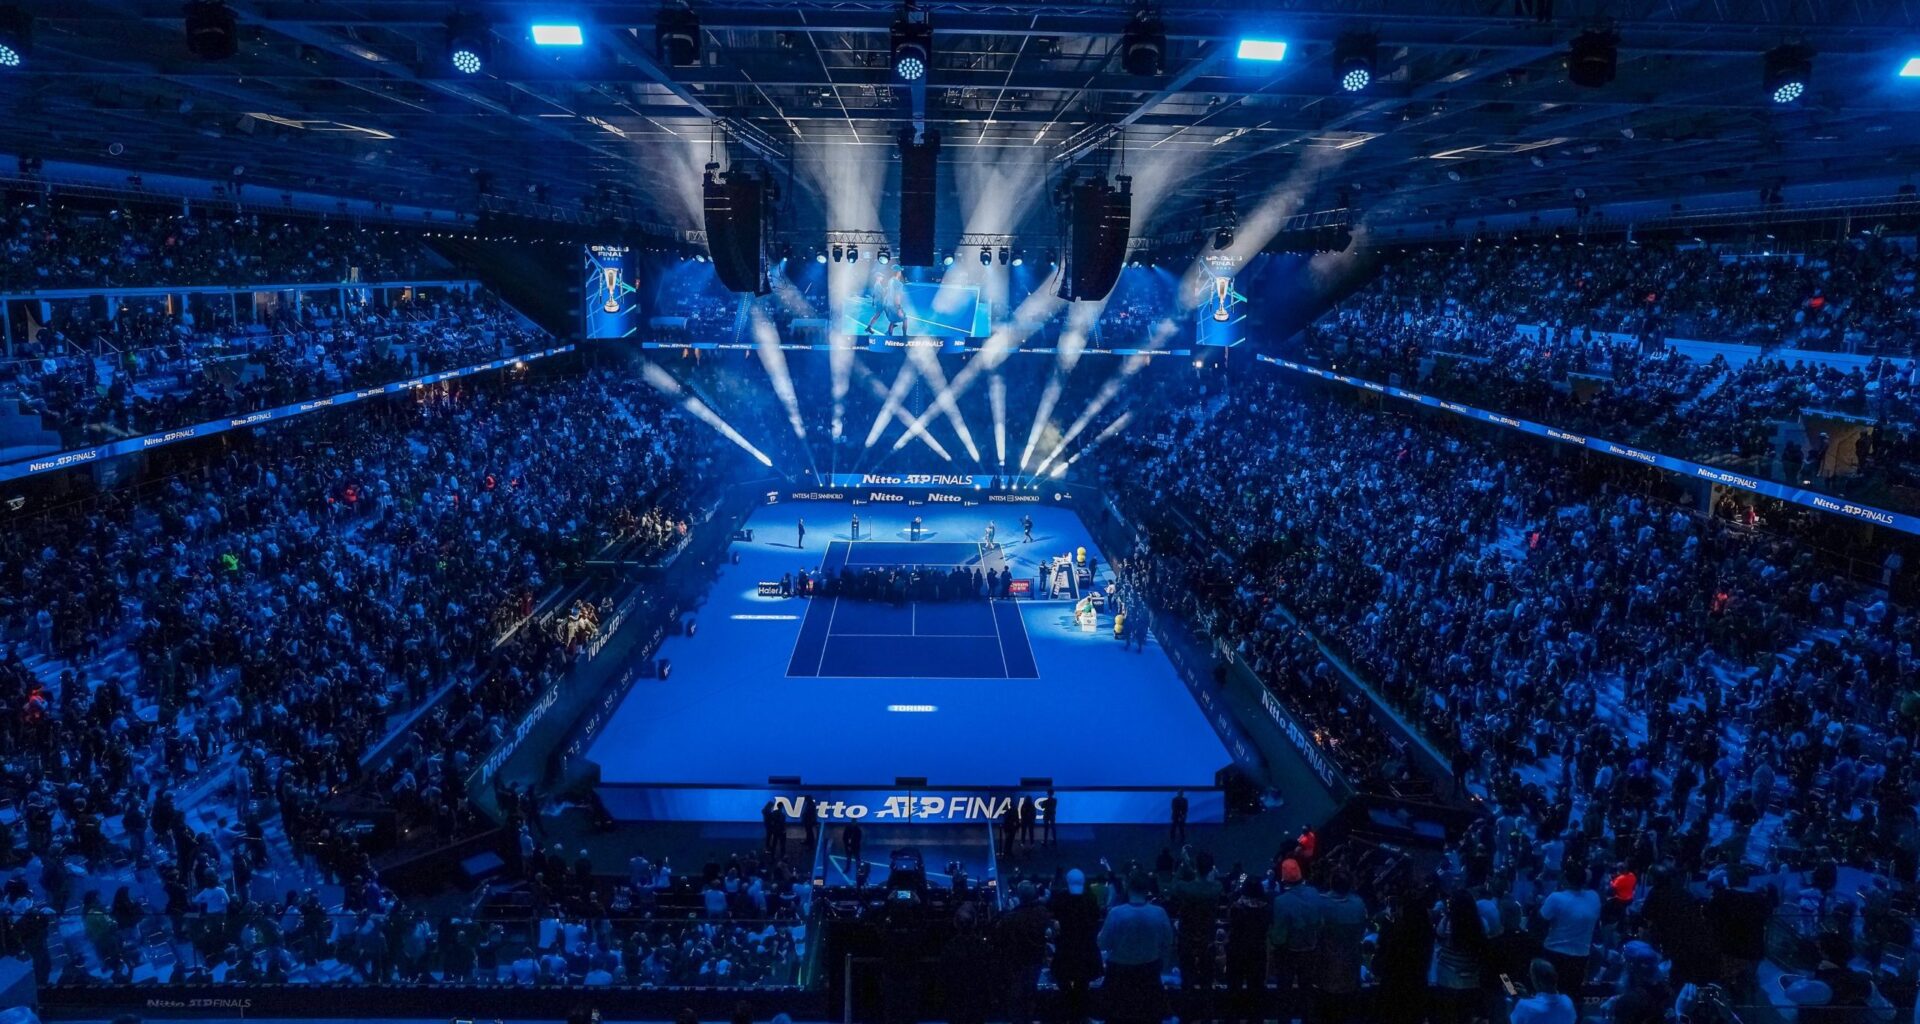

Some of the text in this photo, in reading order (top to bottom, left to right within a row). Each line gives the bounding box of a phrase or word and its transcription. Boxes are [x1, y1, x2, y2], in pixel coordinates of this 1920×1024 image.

[144, 428, 194, 446] Nitto ATP FINALS
[30, 450, 96, 472] Nitto ATP FINALS
[1610, 445, 1625, 455] Nitto
[1637, 453, 1656, 463] FINALS
[862, 474, 972, 485] Nitto ATP FINALS
[1698, 468, 1757, 489] Nitto ATP FINALS
[870, 492, 904, 501] Nitto
[928, 493, 961, 502] Nitto
[1814, 497, 1894, 524] Nitto ATP FINALS
[482, 684, 559, 784] Nitto ATP FINALS
[1262, 690, 1334, 788] Nitto ATP FINALS
[772, 796, 868, 818] Ntto
[874, 796, 944, 819] ATP
[213, 999, 251, 1007] FINALS
